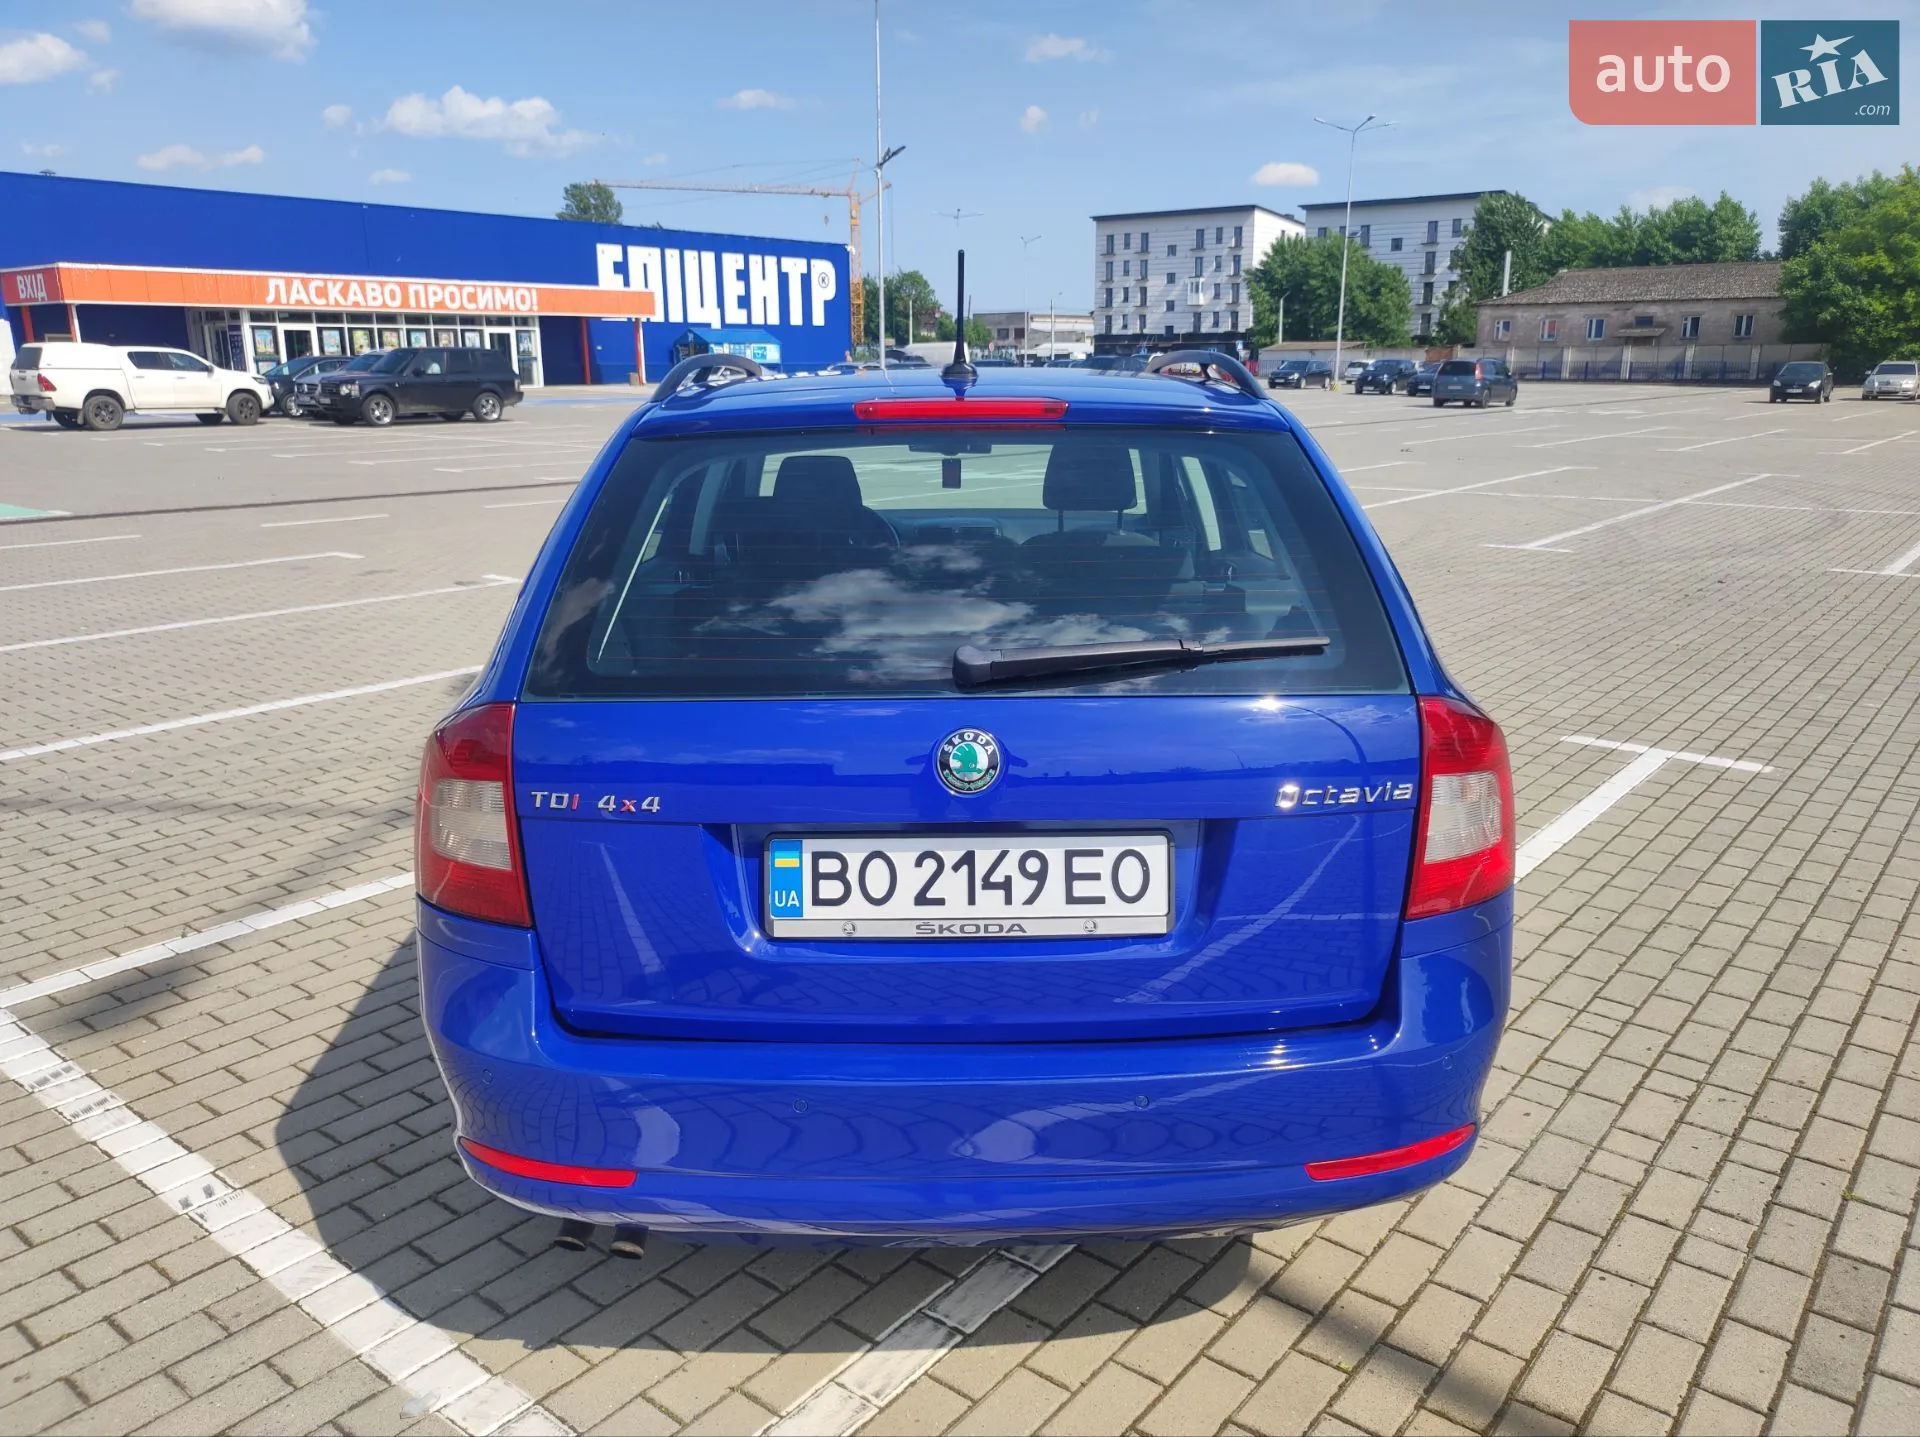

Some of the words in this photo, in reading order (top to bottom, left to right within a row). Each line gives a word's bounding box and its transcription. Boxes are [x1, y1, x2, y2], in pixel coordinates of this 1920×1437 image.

[16, 273, 47, 301] ВХІД
[266, 278, 401, 308] ЛАСКАВО
[408, 284, 539, 311] ПРОСИМО!
[596, 243, 837, 329] ЕПІЦЕНТР
[597, 795, 660, 813] 4x4
[1275, 782, 1414, 808] Octavia
[811, 850, 898, 907] BO
[913, 849, 1049, 907] 2149
[1064, 848, 1151, 905] EO
[775, 890, 799, 907] UA
[915, 921, 1028, 935] ŠKODA
